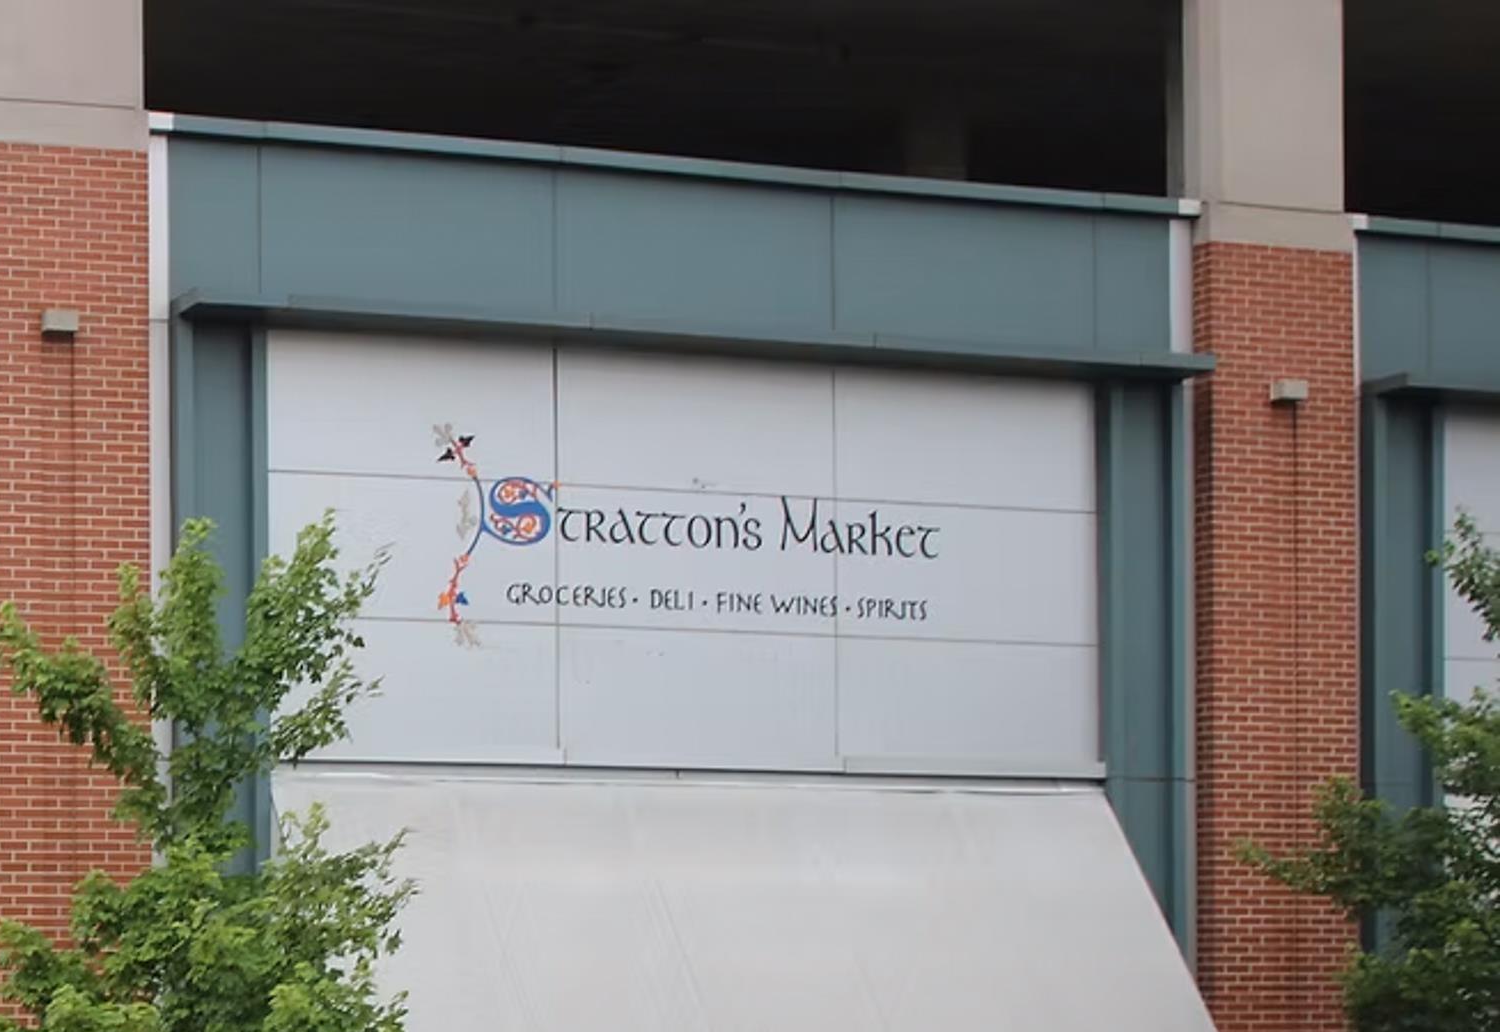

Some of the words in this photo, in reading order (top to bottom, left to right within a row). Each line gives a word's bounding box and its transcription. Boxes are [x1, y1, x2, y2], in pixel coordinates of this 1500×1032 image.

[780, 495, 941, 560] Market
[506, 583, 628, 610] GROCERIES
[650, 587, 695, 612] DELI
[716, 592, 763, 616] FINE
[770, 594, 839, 618] WINES
[856, 597, 929, 622] SPIRITS
